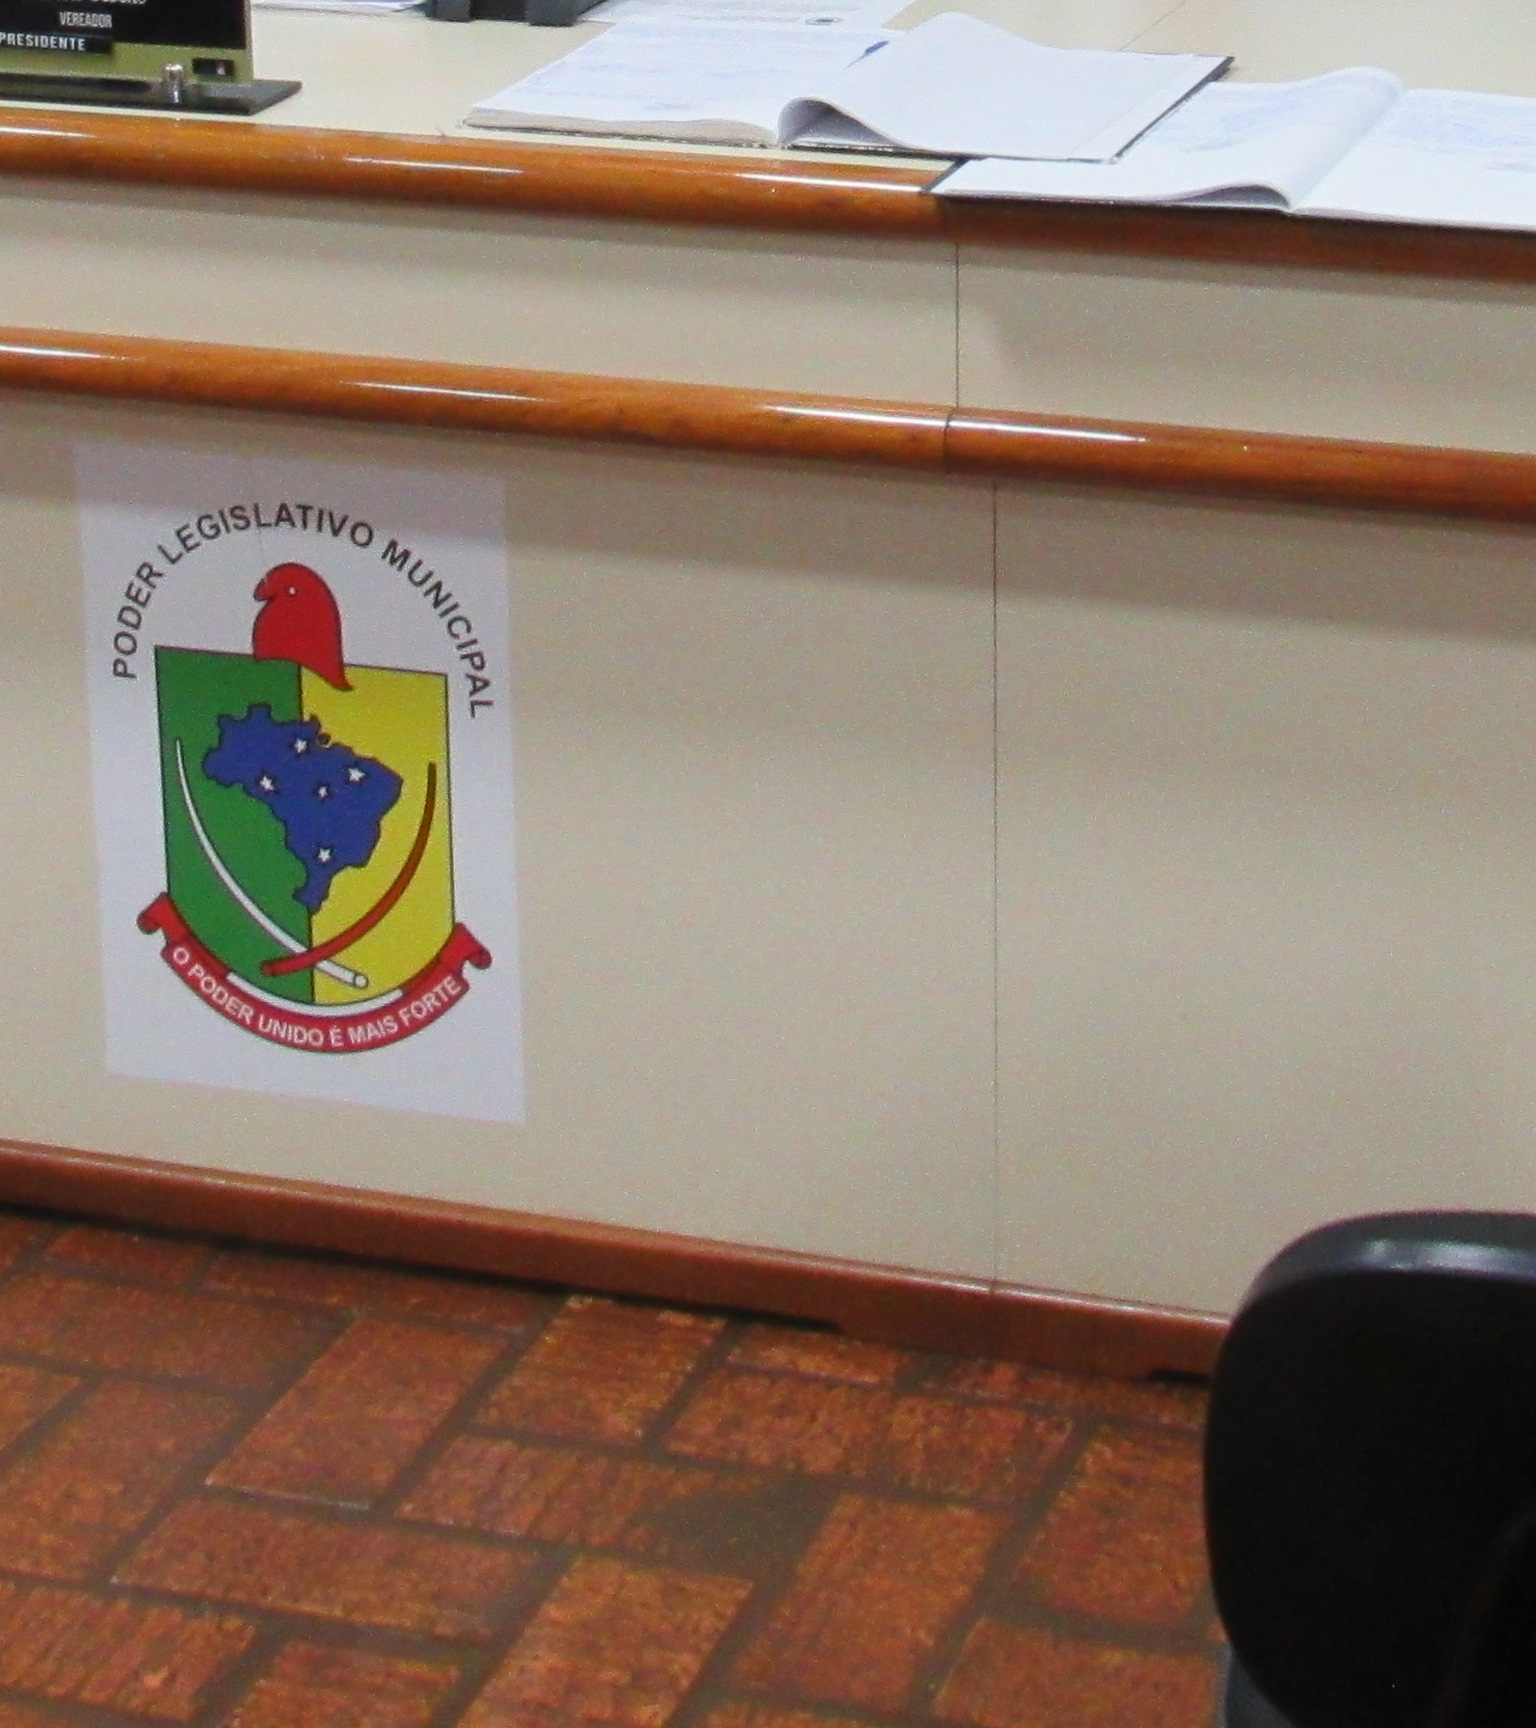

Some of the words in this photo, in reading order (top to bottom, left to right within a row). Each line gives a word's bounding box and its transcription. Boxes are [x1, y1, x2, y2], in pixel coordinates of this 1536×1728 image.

[58, 11, 114, 29] VEREADOR
[112, 560, 165, 681] PODER
[157, 501, 376, 567] LEGISLATIVO
[381, 537, 497, 721] MUNICIPAL
[172, 945, 192, 967] O
[189, 964, 256, 1027] PODER
[258, 1014, 326, 1048] UNIDO
[330, 1022, 346, 1048] É
[349, 1014, 400, 1046] MAIS
[398, 975, 464, 1027] FORTE
